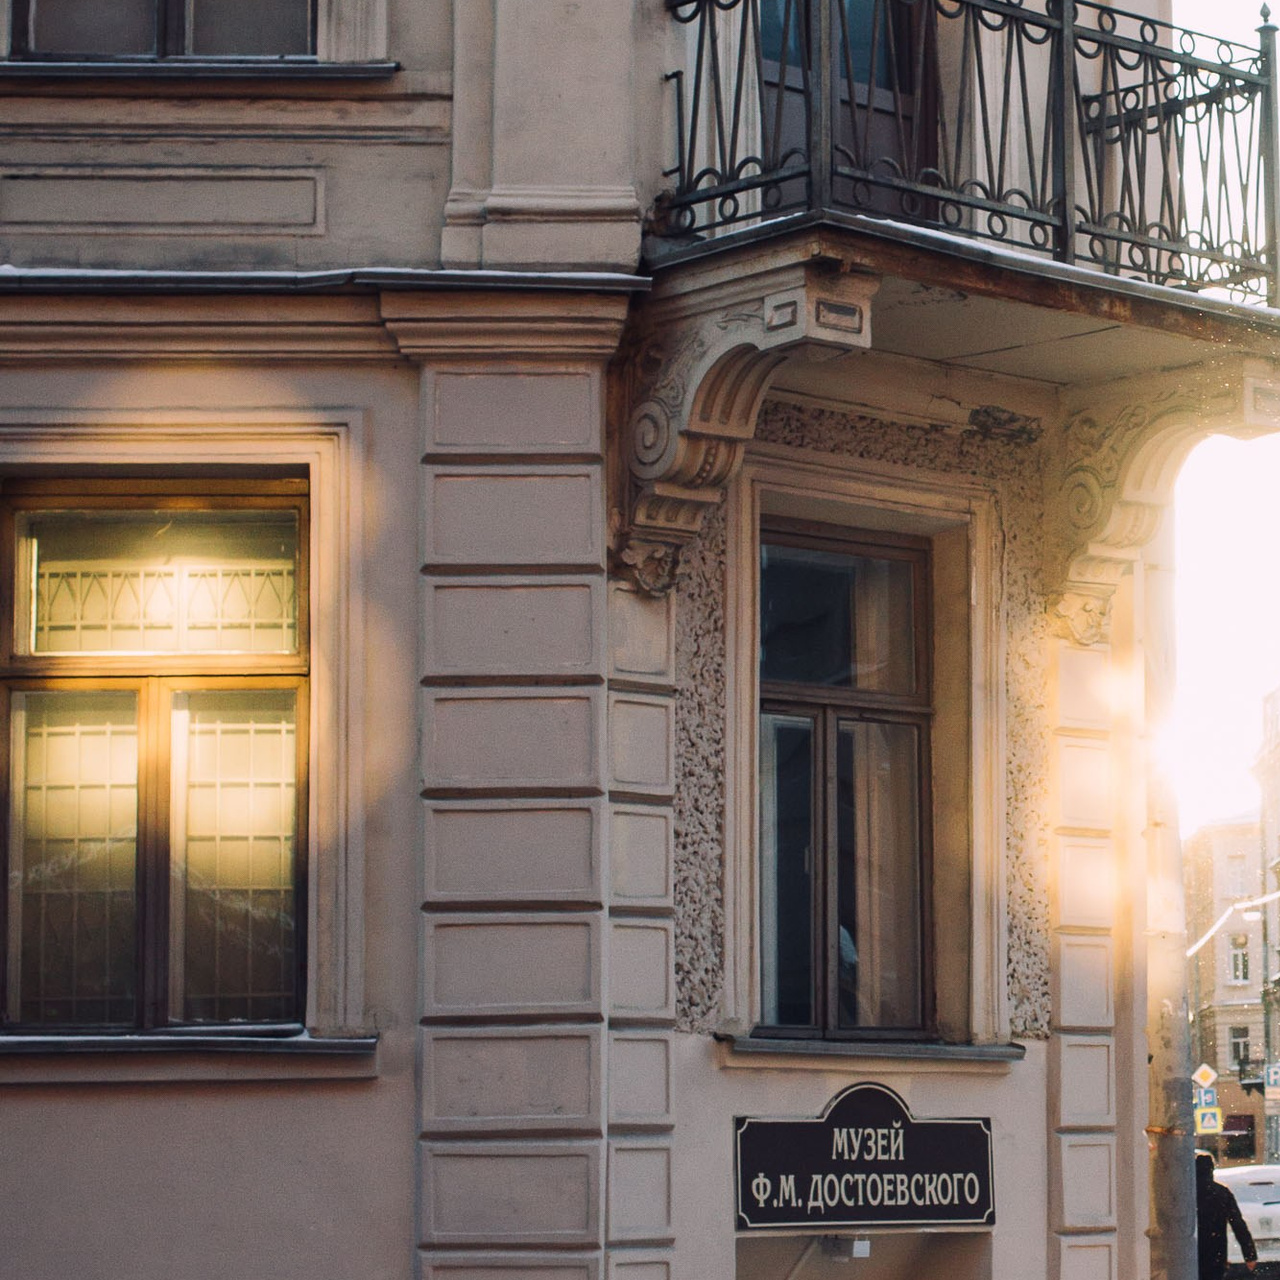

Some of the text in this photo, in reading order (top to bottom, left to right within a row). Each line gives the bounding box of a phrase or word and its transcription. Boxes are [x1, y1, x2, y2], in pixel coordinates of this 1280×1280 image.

[831, 1120, 905, 1161] МУЗЕЙ
[751, 1172, 980, 1214] Ф.М. ДОСТОЕВСКОГО
